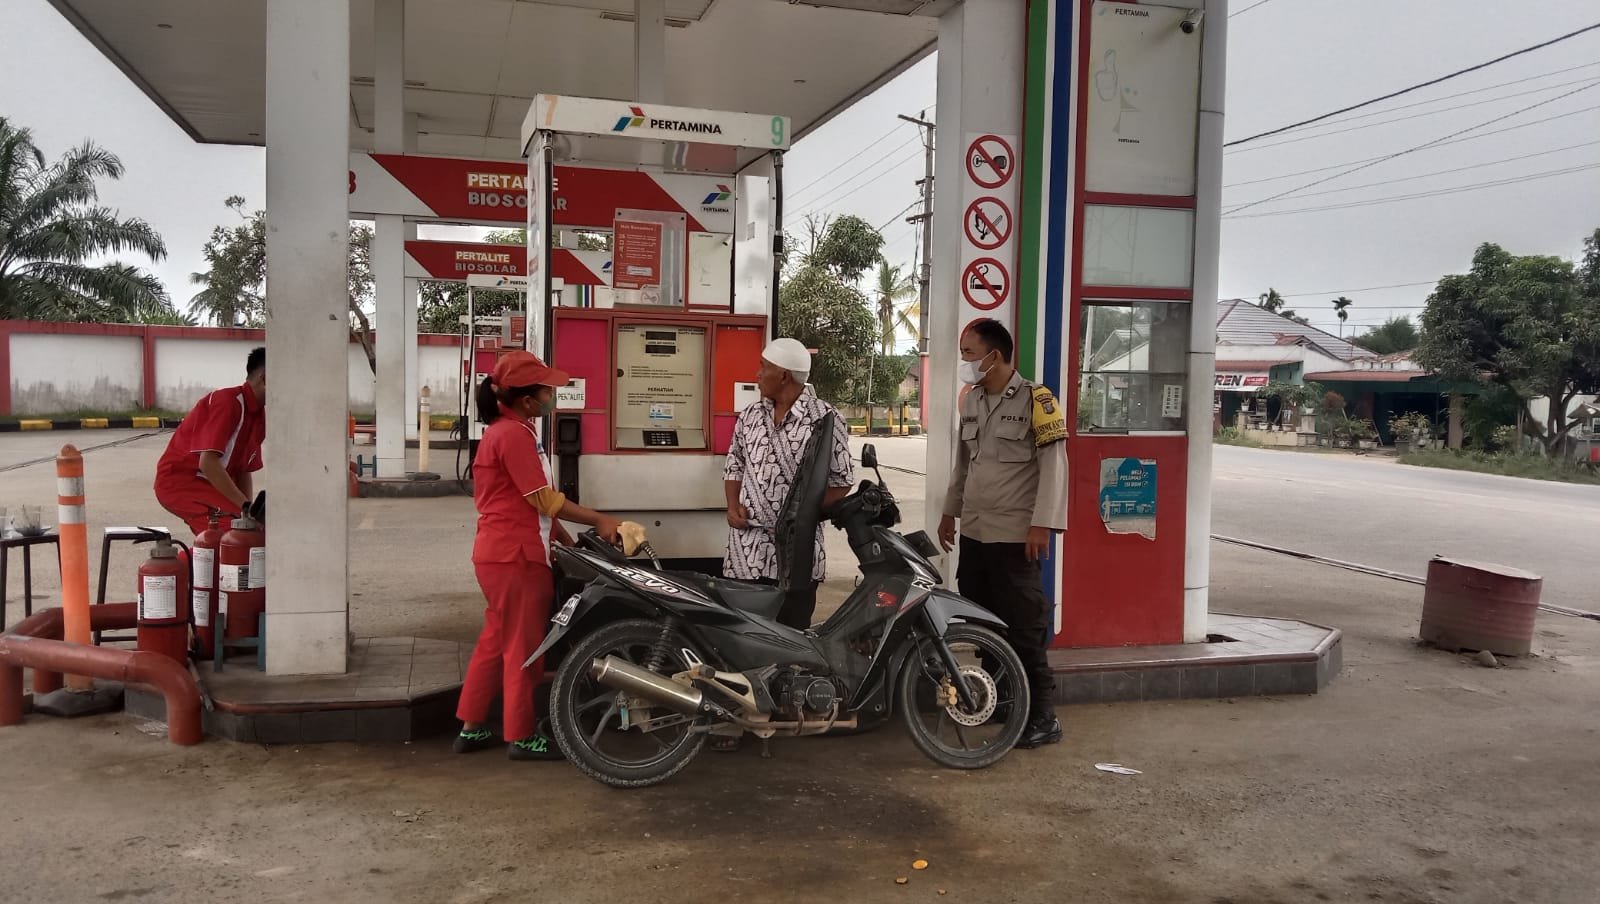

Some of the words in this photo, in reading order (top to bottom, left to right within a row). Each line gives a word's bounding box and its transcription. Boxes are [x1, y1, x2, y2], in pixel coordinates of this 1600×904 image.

[545, 96, 558, 126] 7
[650, 118, 722, 135] PERTAMINA
[771, 116, 785, 146] 9
[467, 173, 559, 191] PERTAE
[468, 192, 568, 210] BIOSOR
[456, 251, 510, 262] PERTALITE
[456, 263, 517, 272] BIOSOLAR
[612, 566, 680, 594] REVO
